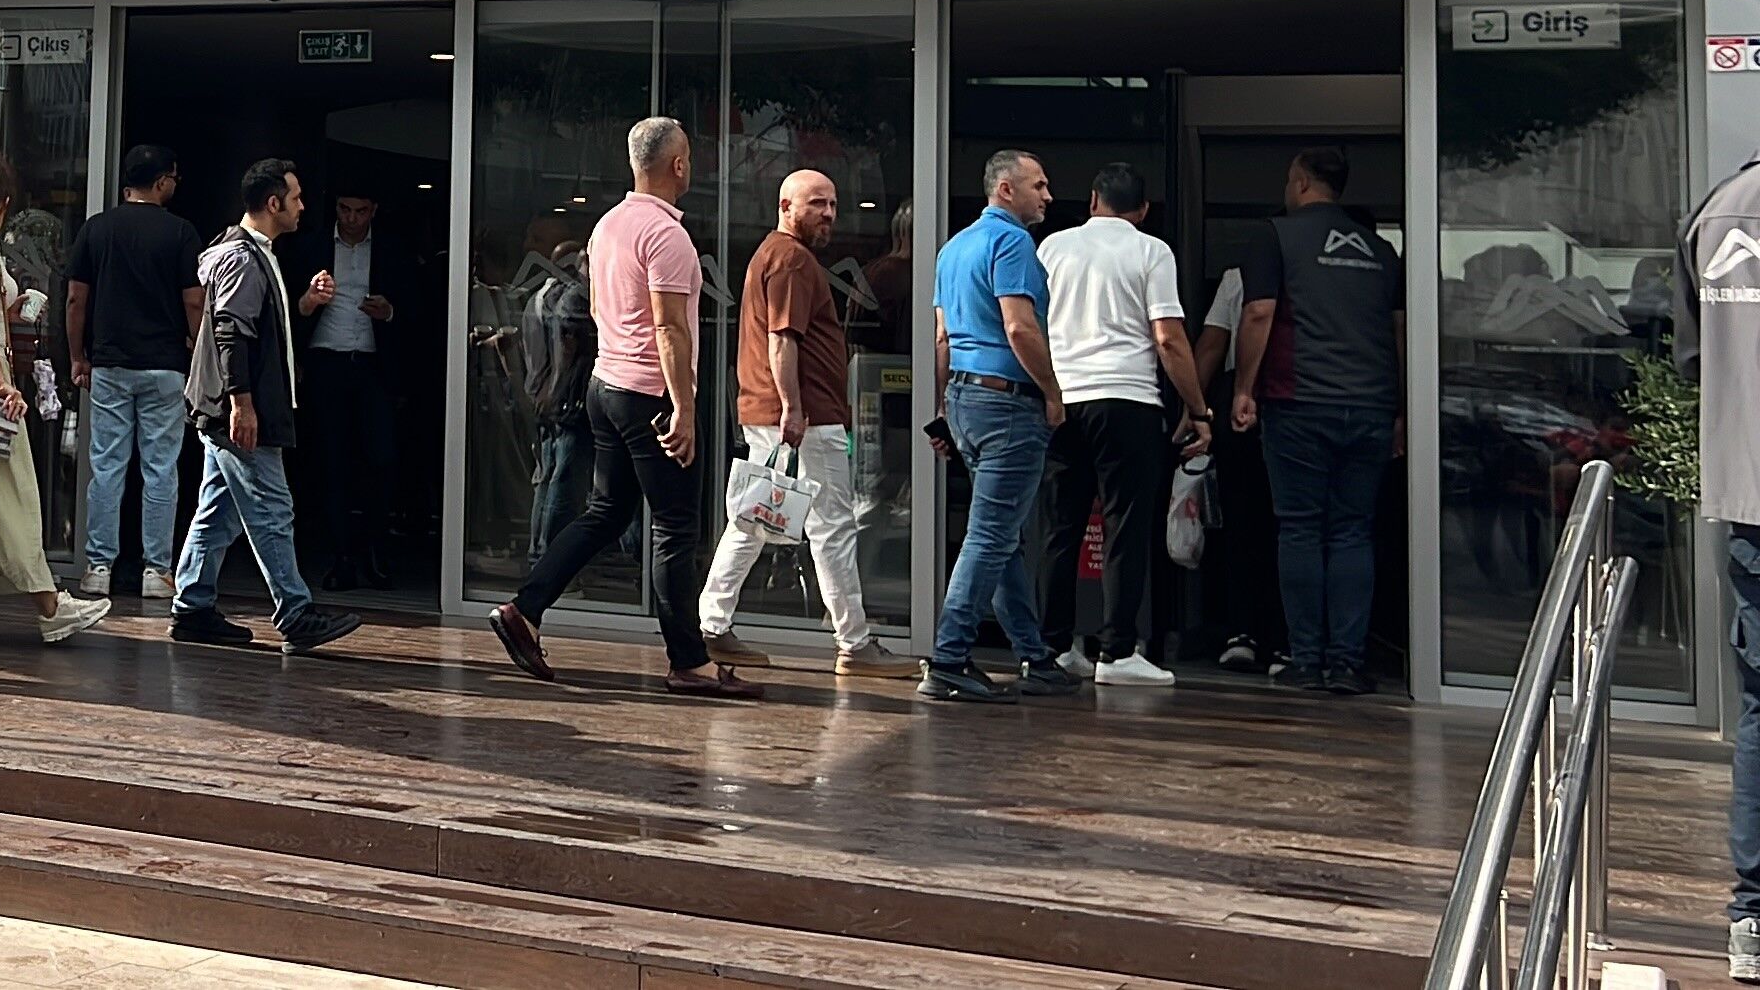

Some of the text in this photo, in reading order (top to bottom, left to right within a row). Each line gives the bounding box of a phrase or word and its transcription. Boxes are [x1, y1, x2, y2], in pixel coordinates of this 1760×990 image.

[1523, 10, 1589, 37] Giriş
[27, 36, 71, 56] Çıkış
[307, 47, 329, 56] EXIT
